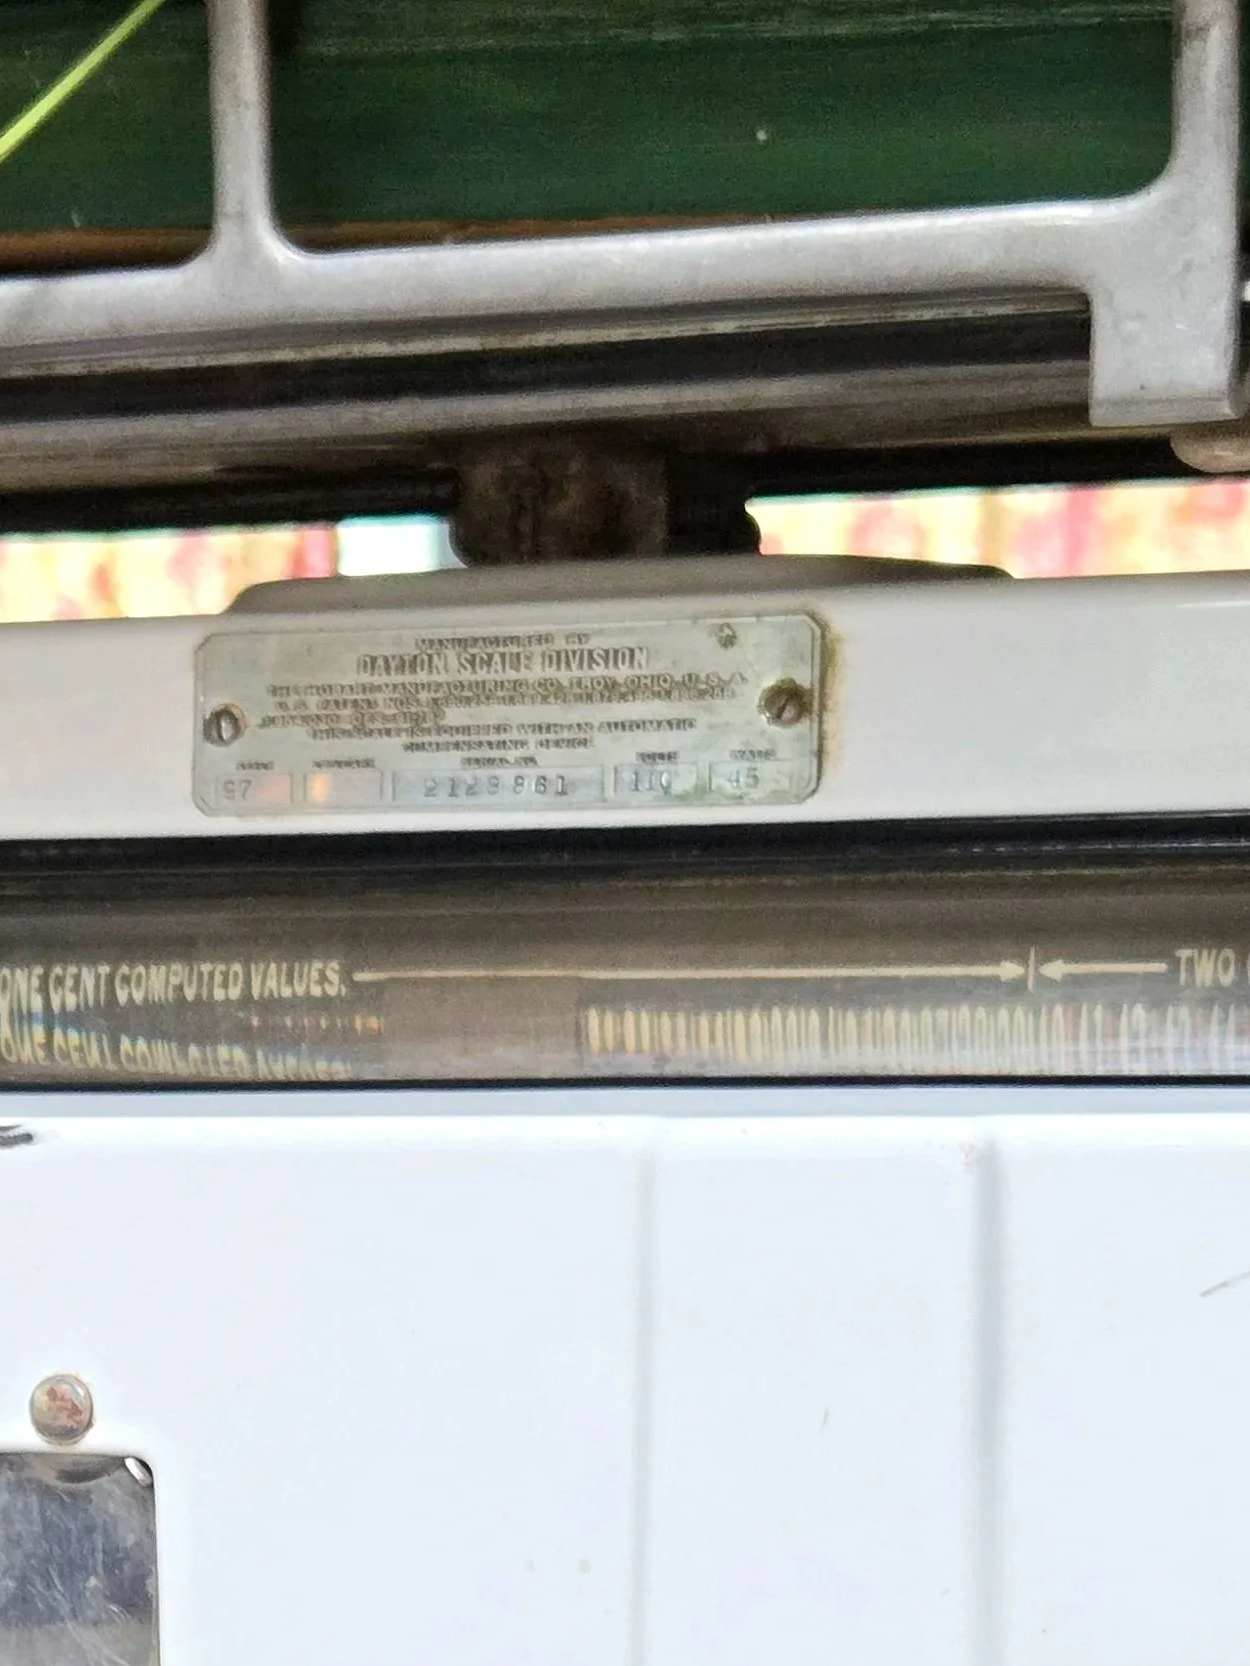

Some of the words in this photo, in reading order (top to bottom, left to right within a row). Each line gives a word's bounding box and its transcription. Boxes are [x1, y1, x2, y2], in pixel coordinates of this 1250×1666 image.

[356, 654, 451, 677] DAYTON
[457, 651, 535, 675] SCALE
[540, 647, 650, 673] DIVISION
[49, 962, 111, 1012] CENT
[115, 960, 243, 1006] COMPUTED
[1174, 947, 1236, 988] TWO
